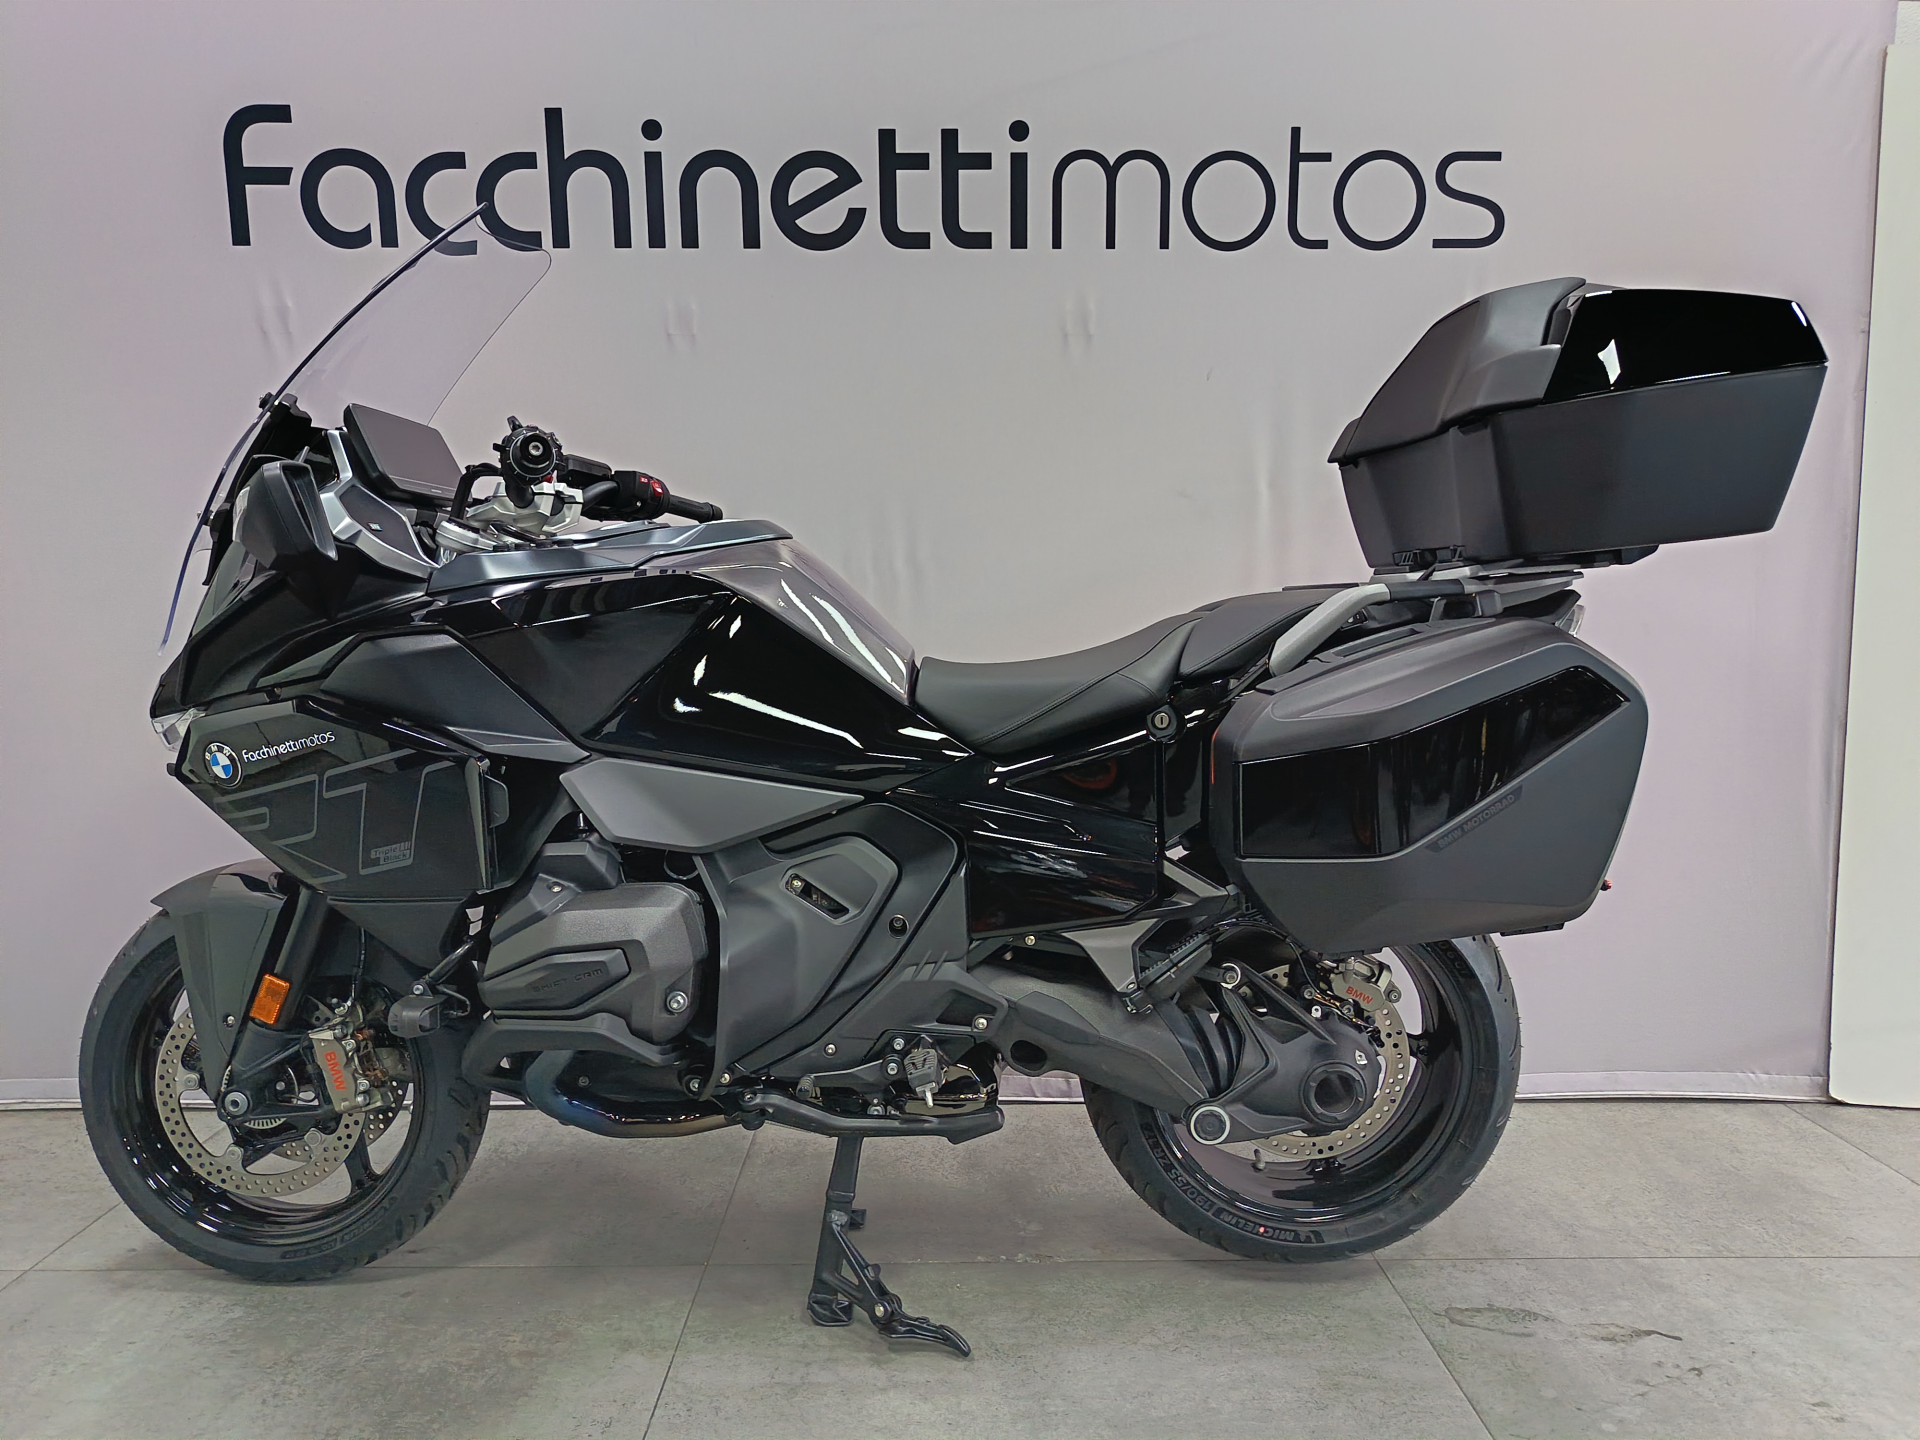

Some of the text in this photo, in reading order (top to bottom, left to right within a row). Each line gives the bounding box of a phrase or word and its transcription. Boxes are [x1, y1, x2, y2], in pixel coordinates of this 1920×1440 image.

[1437, 794, 1515, 848] BMW MOTORRAD
[1346, 986, 1374, 1005] BMW
[324, 1051, 347, 1090] BMW
[1219, 1211, 1295, 1241] MICHELIN
